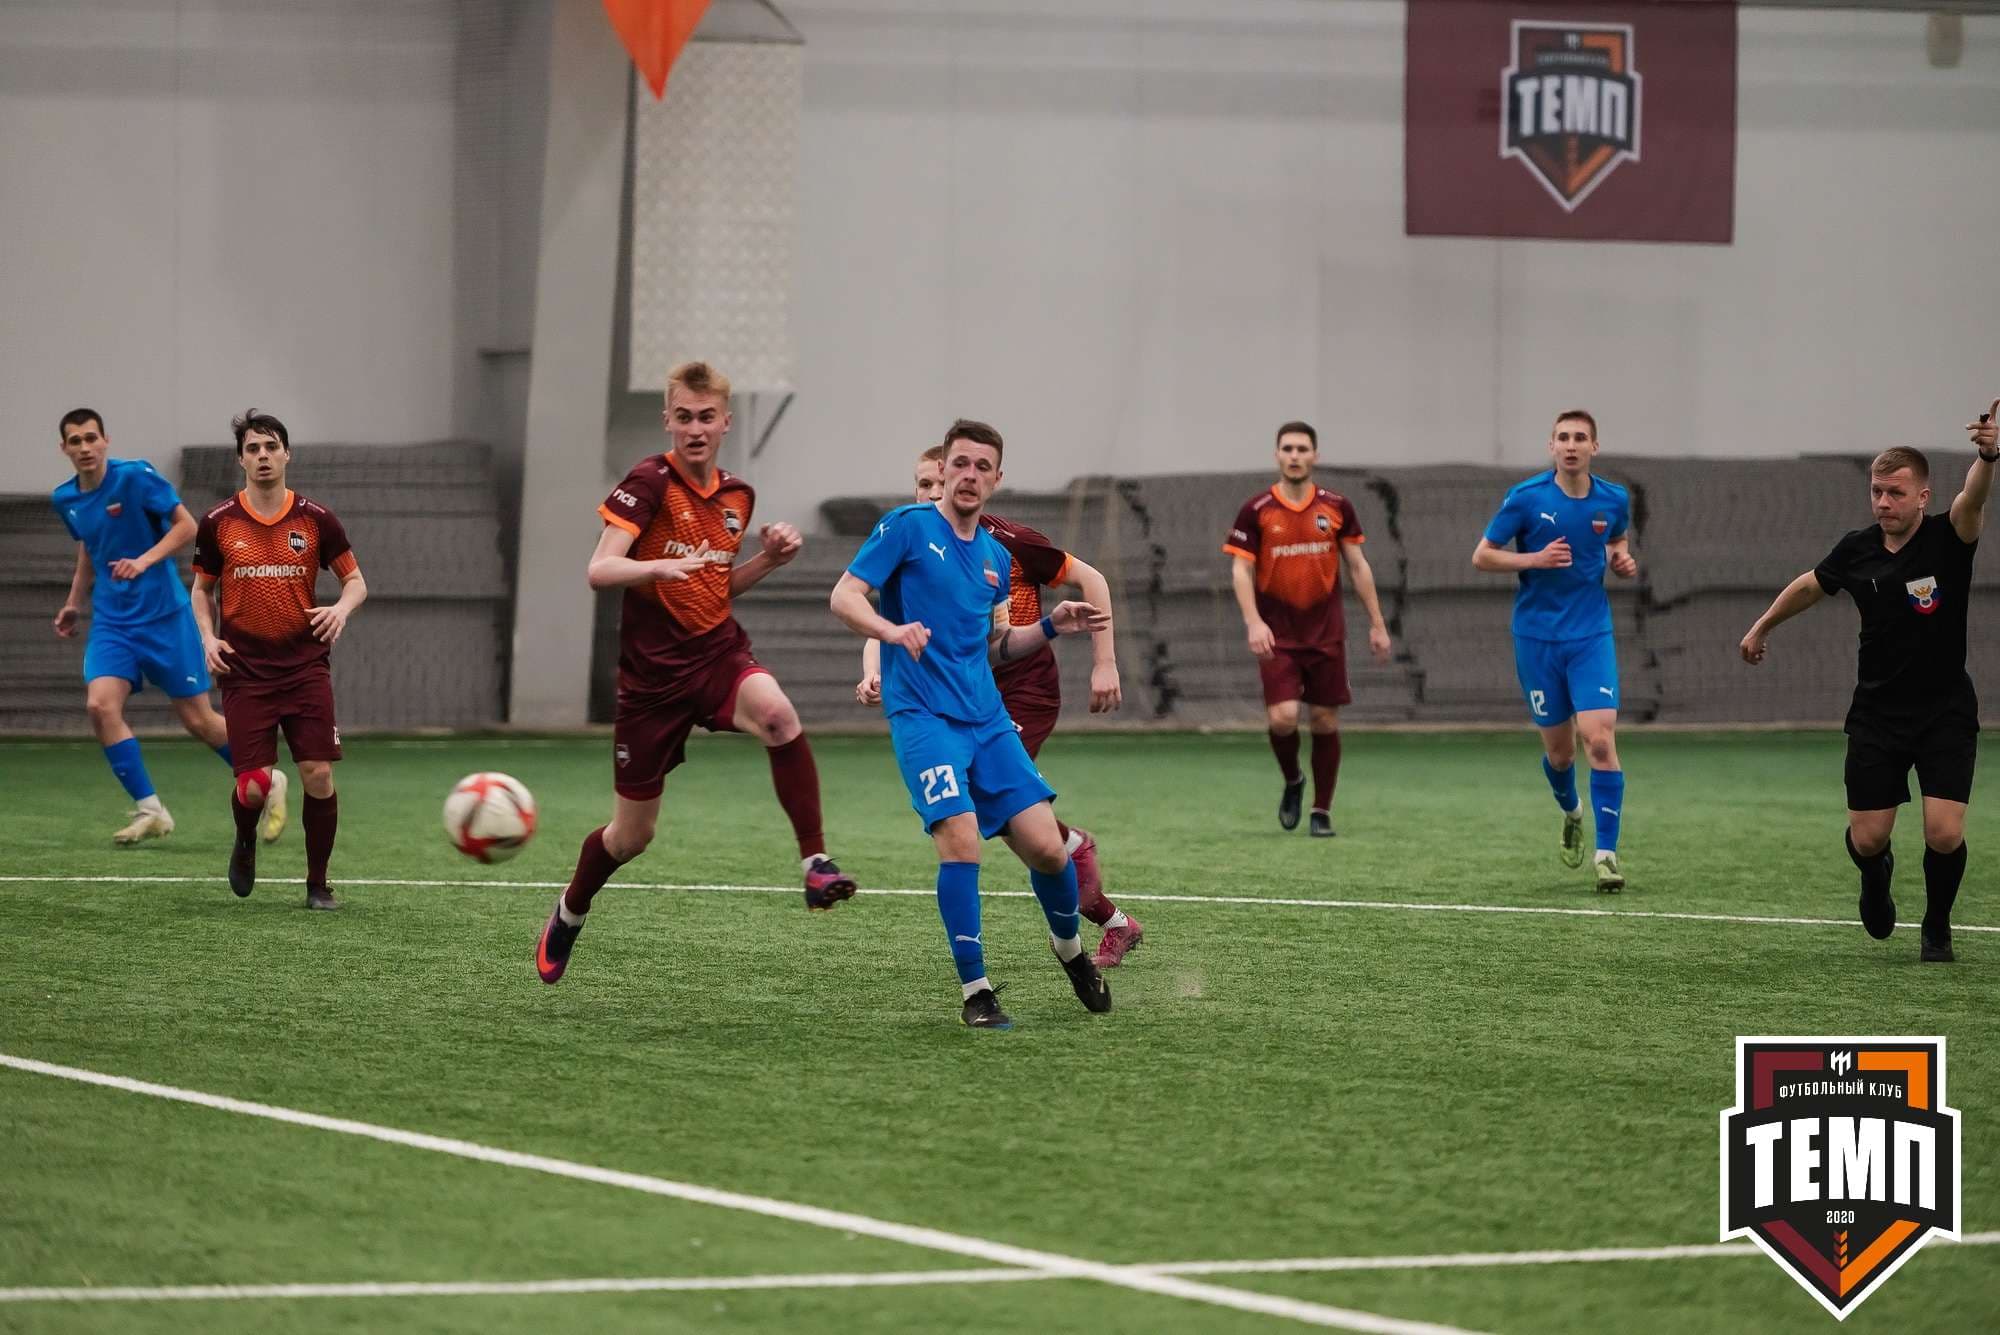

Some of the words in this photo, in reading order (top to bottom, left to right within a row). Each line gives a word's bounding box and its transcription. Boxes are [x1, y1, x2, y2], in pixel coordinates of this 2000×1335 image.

[1515, 75, 1628, 141] ТЕМП
[613, 489, 638, 507] ПСБ
[1530, 690, 1548, 716] 12
[919, 764, 960, 805] 23
